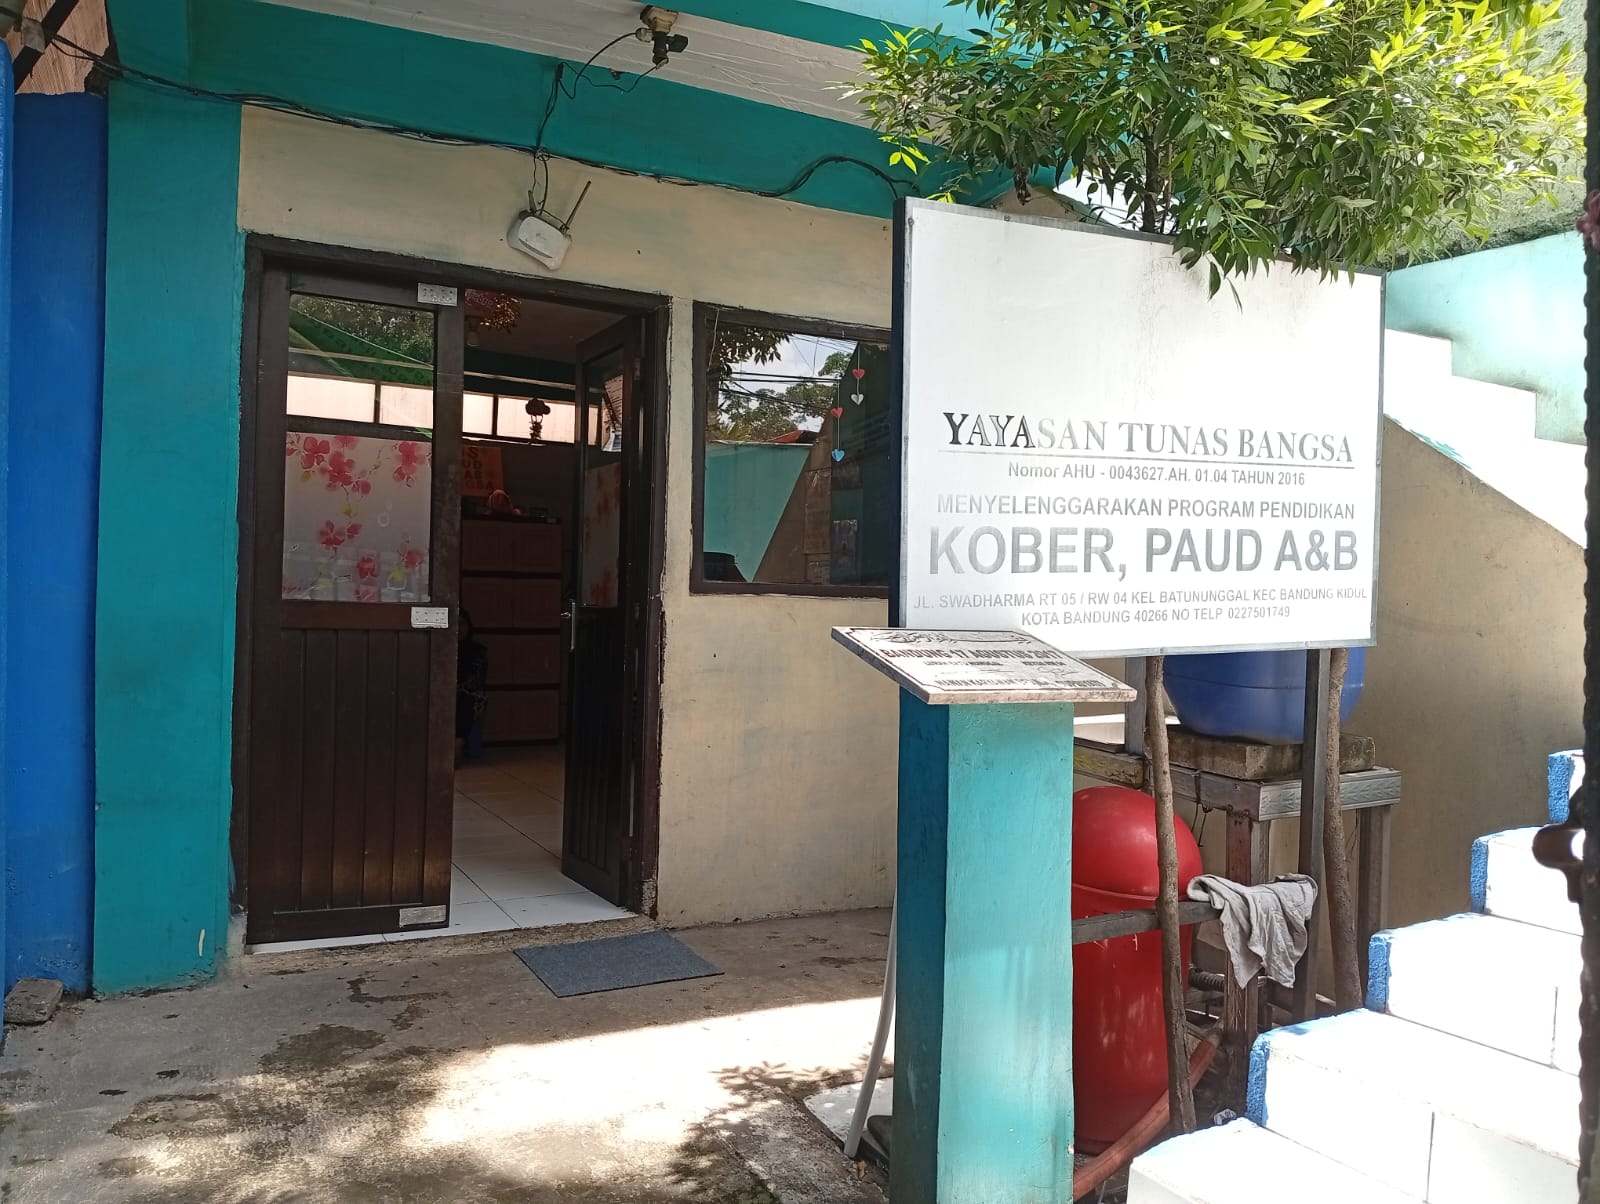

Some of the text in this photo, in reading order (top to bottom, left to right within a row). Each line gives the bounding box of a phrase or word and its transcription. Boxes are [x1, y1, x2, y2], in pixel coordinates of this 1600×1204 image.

[943, 412, 1353, 463] YAYASAN TUNAS BANGSA
[1008, 461, 1060, 478] Nomor
[1062, 463, 1096, 479] AHU
[1108, 465, 1191, 482] 0043627.AH.
[1195, 468, 1228, 483] 01.04
[1231, 469, 1275, 485] TAHUN
[1277, 471, 1306, 486] 2016
[937, 493, 1355, 520] MENYELENGGARAKAN PROGRAM PENDIDIKAN
[929, 525, 1359, 582] KOBER, PAUD A&B
[913, 594, 935, 610] JL.
[938, 592, 1036, 609] SWADHARMA
[1038, 592, 1057, 607] RT
[1060, 592, 1077, 606] 05
[1087, 591, 1110, 606] RW
[1112, 591, 1128, 605] 04
[1130, 591, 1156, 605] KEL
[1159, 588, 1250, 604] BATUNUNGGAL
[1253, 588, 1277, 602] KEC
[1279, 587, 1335, 600] BANDUNG
[1336, 587, 1369, 599] KIDUL
[1021, 605, 1291, 626] KOTA BANDUNG 40266 NO TELP 0227501749
